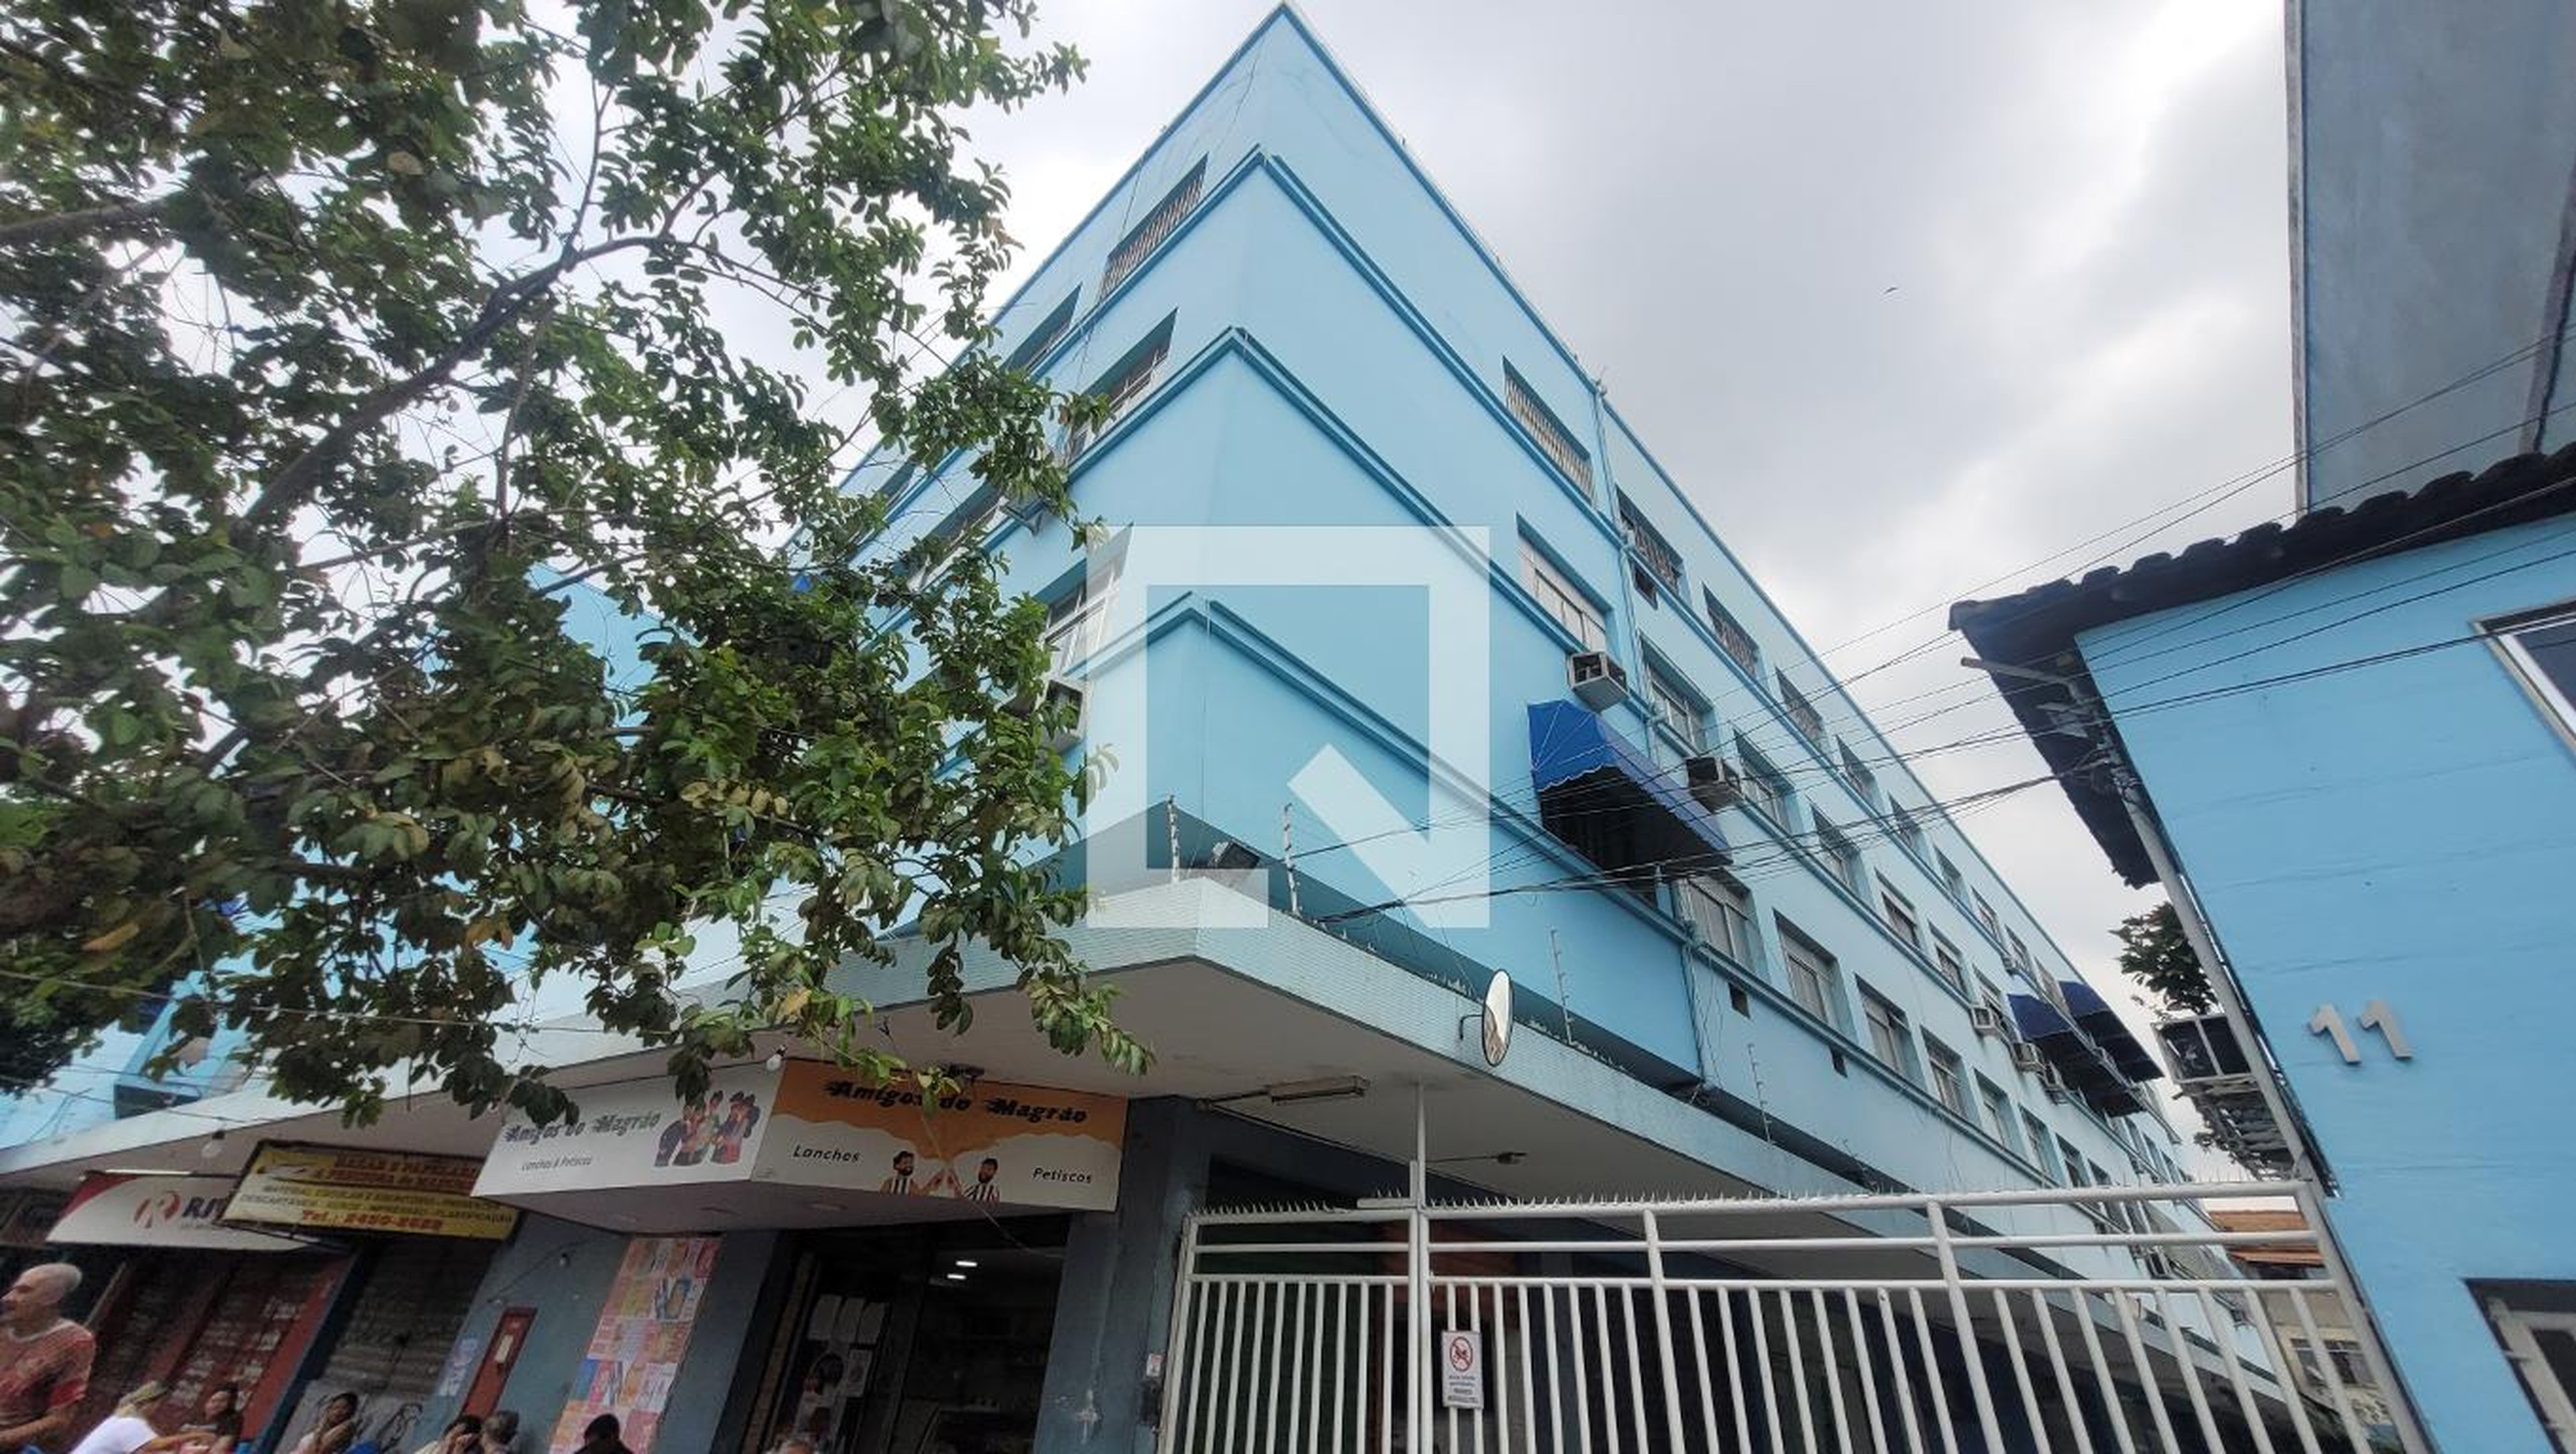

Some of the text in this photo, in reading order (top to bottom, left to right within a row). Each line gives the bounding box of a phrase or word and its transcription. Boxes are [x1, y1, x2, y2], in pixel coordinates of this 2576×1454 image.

[2307, 999, 2413, 1066] 11
[793, 1145, 861, 1162] Lanches
[1032, 1167, 1092, 1184] Petiscos
